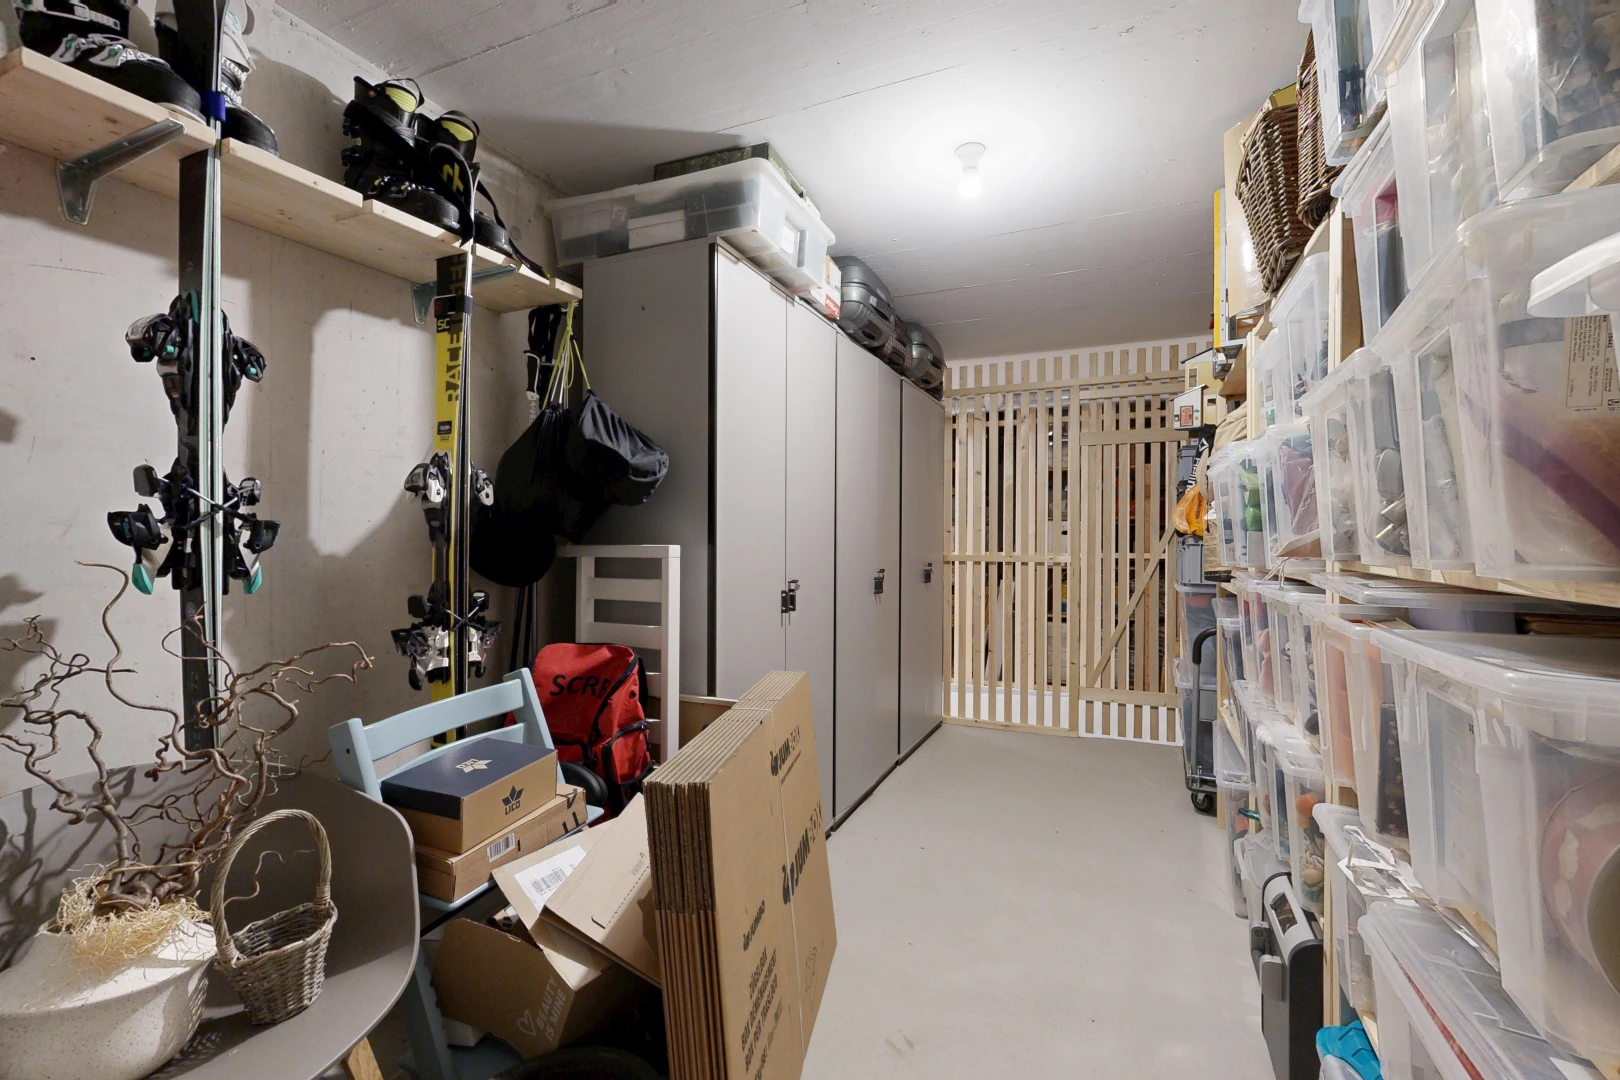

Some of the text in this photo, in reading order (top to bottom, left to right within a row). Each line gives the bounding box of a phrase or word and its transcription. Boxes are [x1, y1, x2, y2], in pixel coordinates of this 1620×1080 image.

[505, 800, 520, 815] LICO
[536, 975, 557, 1030] BEAUTY
[545, 988, 566, 1041] IS MINE
